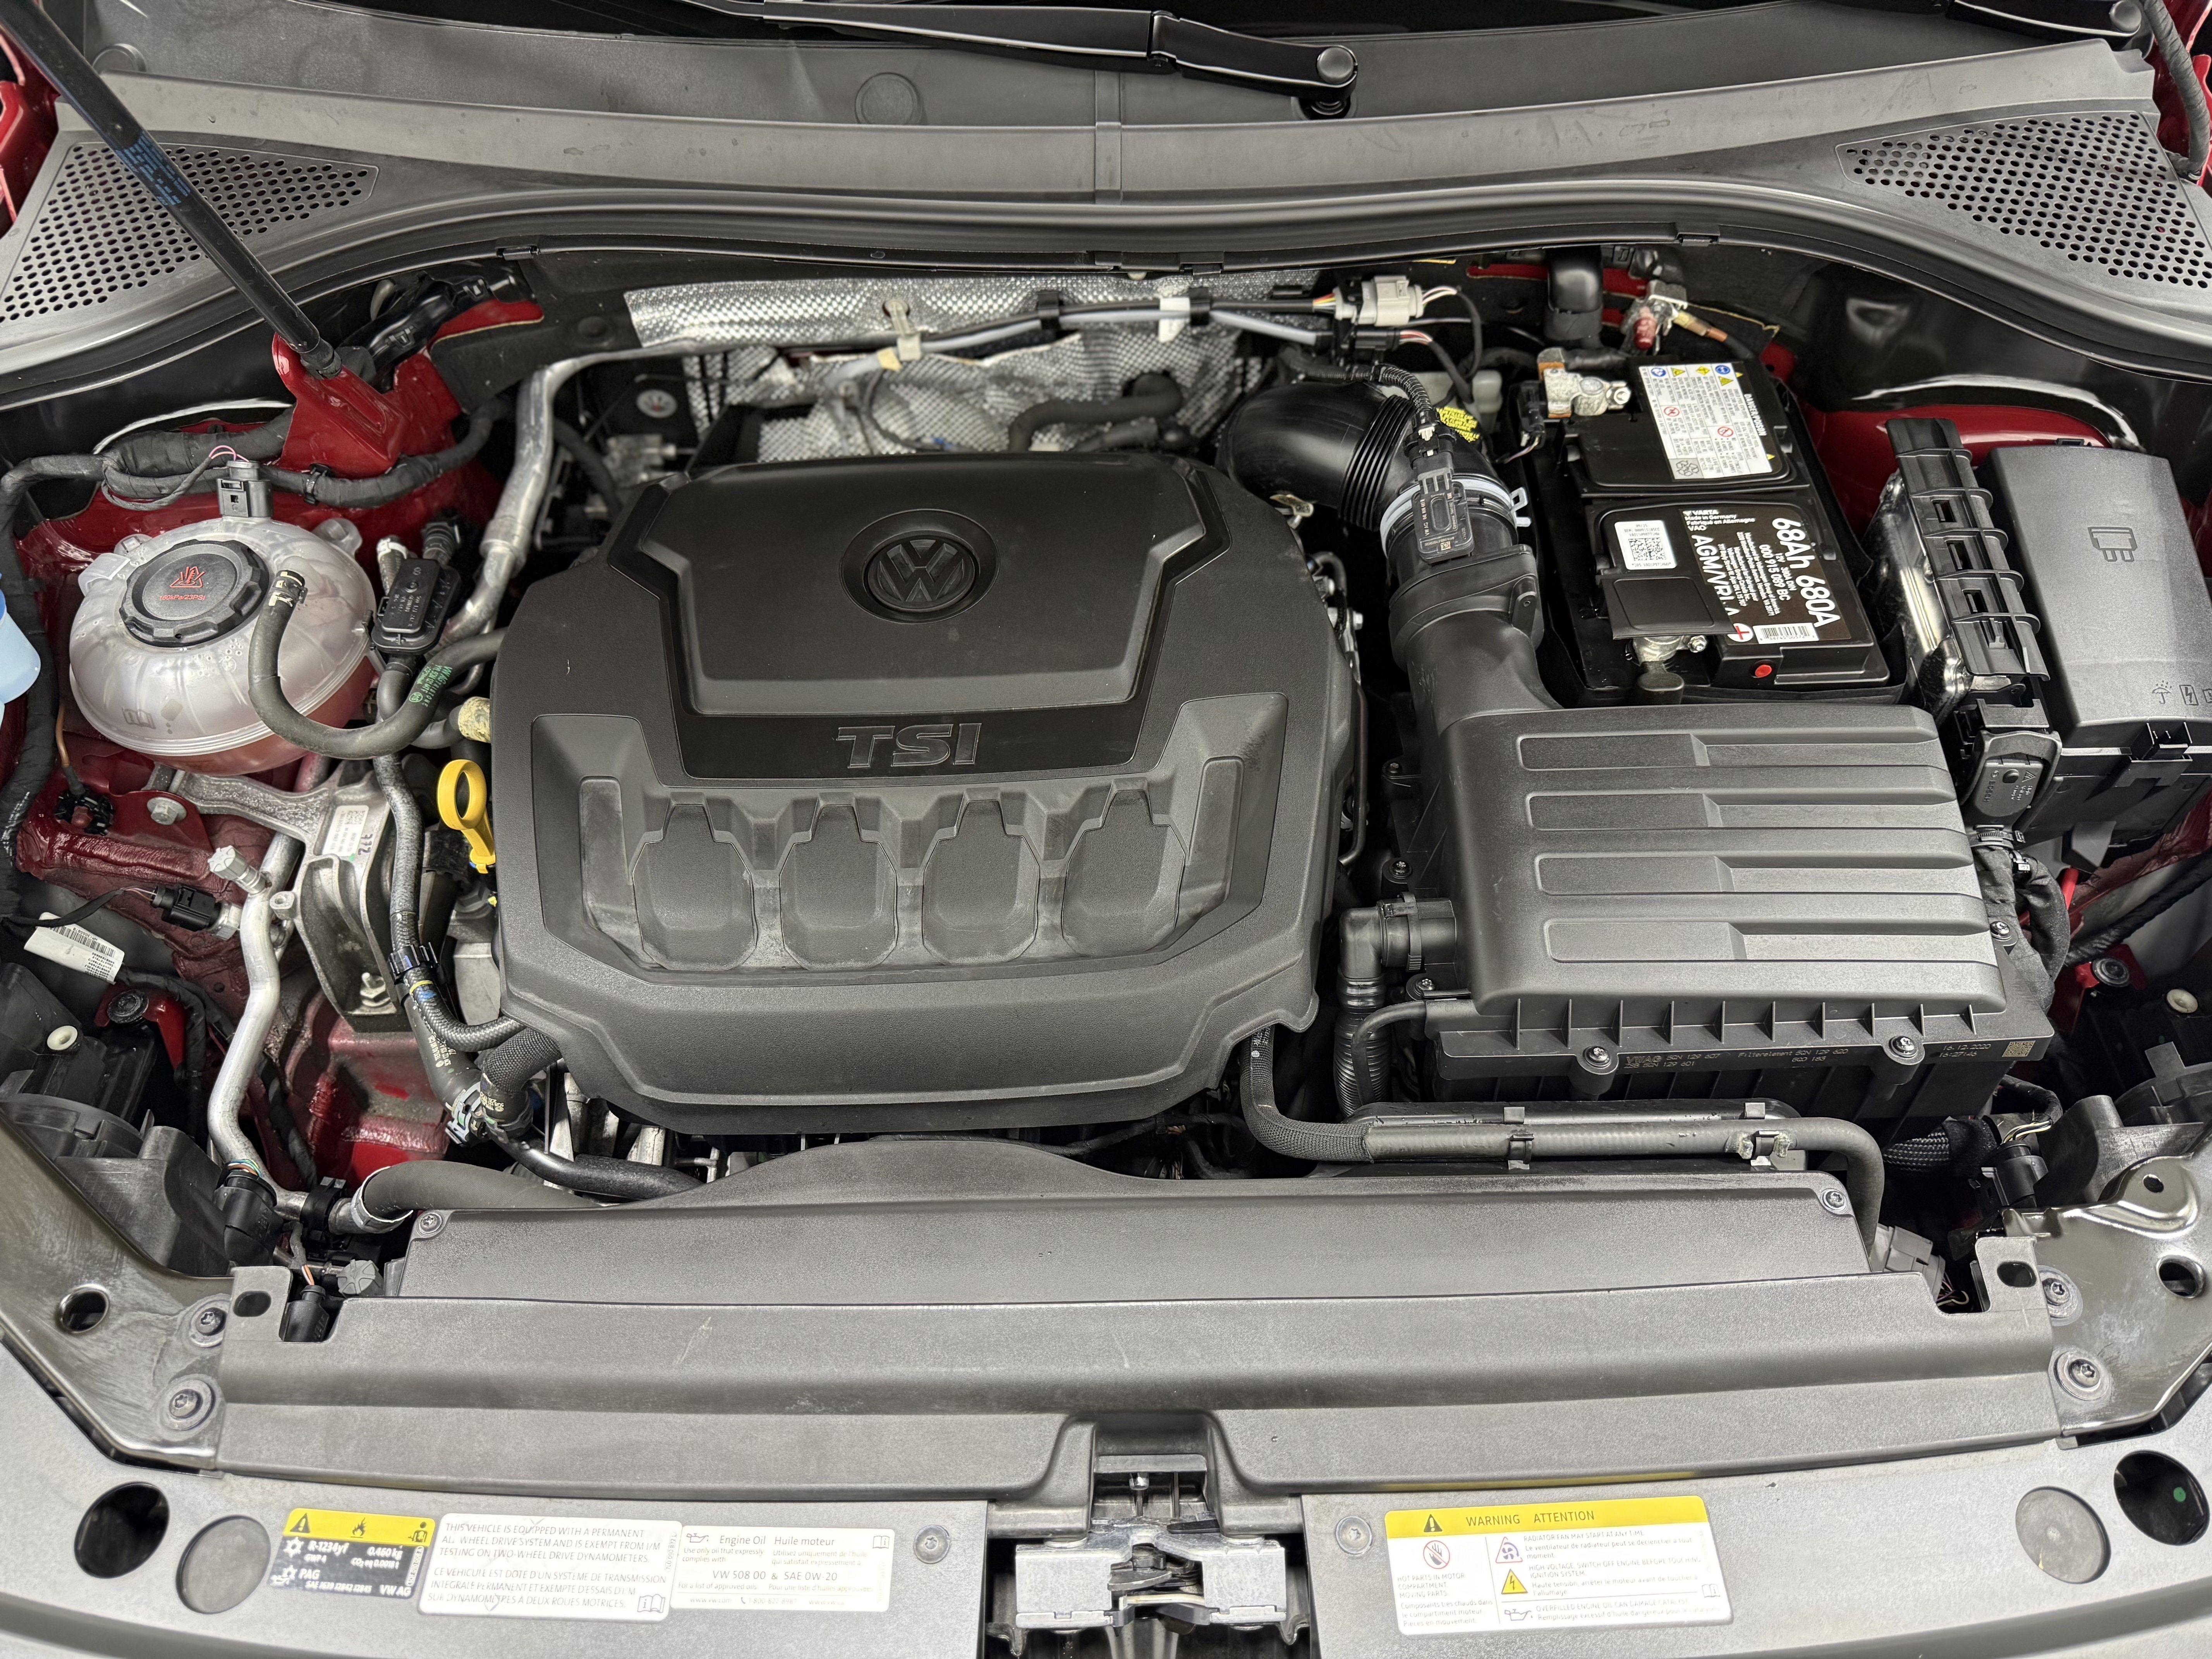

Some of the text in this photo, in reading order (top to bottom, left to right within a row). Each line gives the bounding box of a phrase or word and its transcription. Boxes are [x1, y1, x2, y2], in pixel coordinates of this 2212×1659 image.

[1744, 394, 1767, 436] DANGER/POISON
[1759, 544, 1791, 601] 000 915 089 BC
[1772, 518, 1841, 628] 68Ah 680A
[1775, 553, 1786, 563] 12V
[1786, 581, 1797, 591] DIN
[836, 723, 982, 769] TSI
[1465, 1510, 1595, 1527] WARNING ATTENTION
[446, 1523, 464, 1532] THIS
[466, 1524, 503, 1533] VEHICLE
[513, 1525, 556, 1535] EQUIPPED
[558, 1527, 582, 1535] WITH
[583, 1527, 589, 1535] A
[591, 1528, 646, 1538] PERMANENT
[460, 1535, 661, 1551] WHEEL DRIVE SYSTEM AND IS EXEMPT FROM I/M
[719, 1535, 766, 1547] Engine Oil
[774, 1536, 836, 1546] Huile moteur
[1523, 1534, 1555, 1542] RADIATOR
[307, 1541, 350, 1557] R-1234yf
[1534, 1543, 1570, 1551] ventilateur
[1611, 1540, 1627, 1549] peut
[367, 1546, 403, 1561] 0.460 kg
[440, 1547, 575, 1560] TESTING ON TWO-WHEEL DRIVE
[697, 1547, 710, 1556] only
[735, 1548, 764, 1557] expressly
[798, 1550, 838, 1558] uniquement
[304, 1553, 327, 1564] GWP 4
[682, 1556, 710, 1564] complies
[771, 1558, 782, 1566] qui
[1616, 1559, 1640, 1567] ENGINE
[298, 1568, 321, 1580] PAG
[433, 1567, 667, 1583] CE EST D'UN DE TRANSMISSION
[713, 1570, 730, 1579] VW
[732, 1570, 750, 1580] 508
[753, 1570, 766, 1580] 00
[783, 1571, 803, 1580] SAE
[805, 1572, 838, 1581] 0W-20
[1397, 1575, 1410, 1583] HOT
[305, 1580, 319, 1589] SAE
[379, 1584, 412, 1597] VW AG
[476, 1581, 613, 1594] PERMANENT ET D'ESSAIS
[714, 1582, 745, 1591] approved
[768, 1583, 782, 1591] Pour
[427, 1592, 580, 1606] SUR DEUX ROUES
[1399, 1590, 1426, 1599] MOVING
[1401, 1602, 1440, 1611] Composants
[1454, 1599, 1477, 1607] chauds
[1410, 1611, 1456, 1620] compartiment
